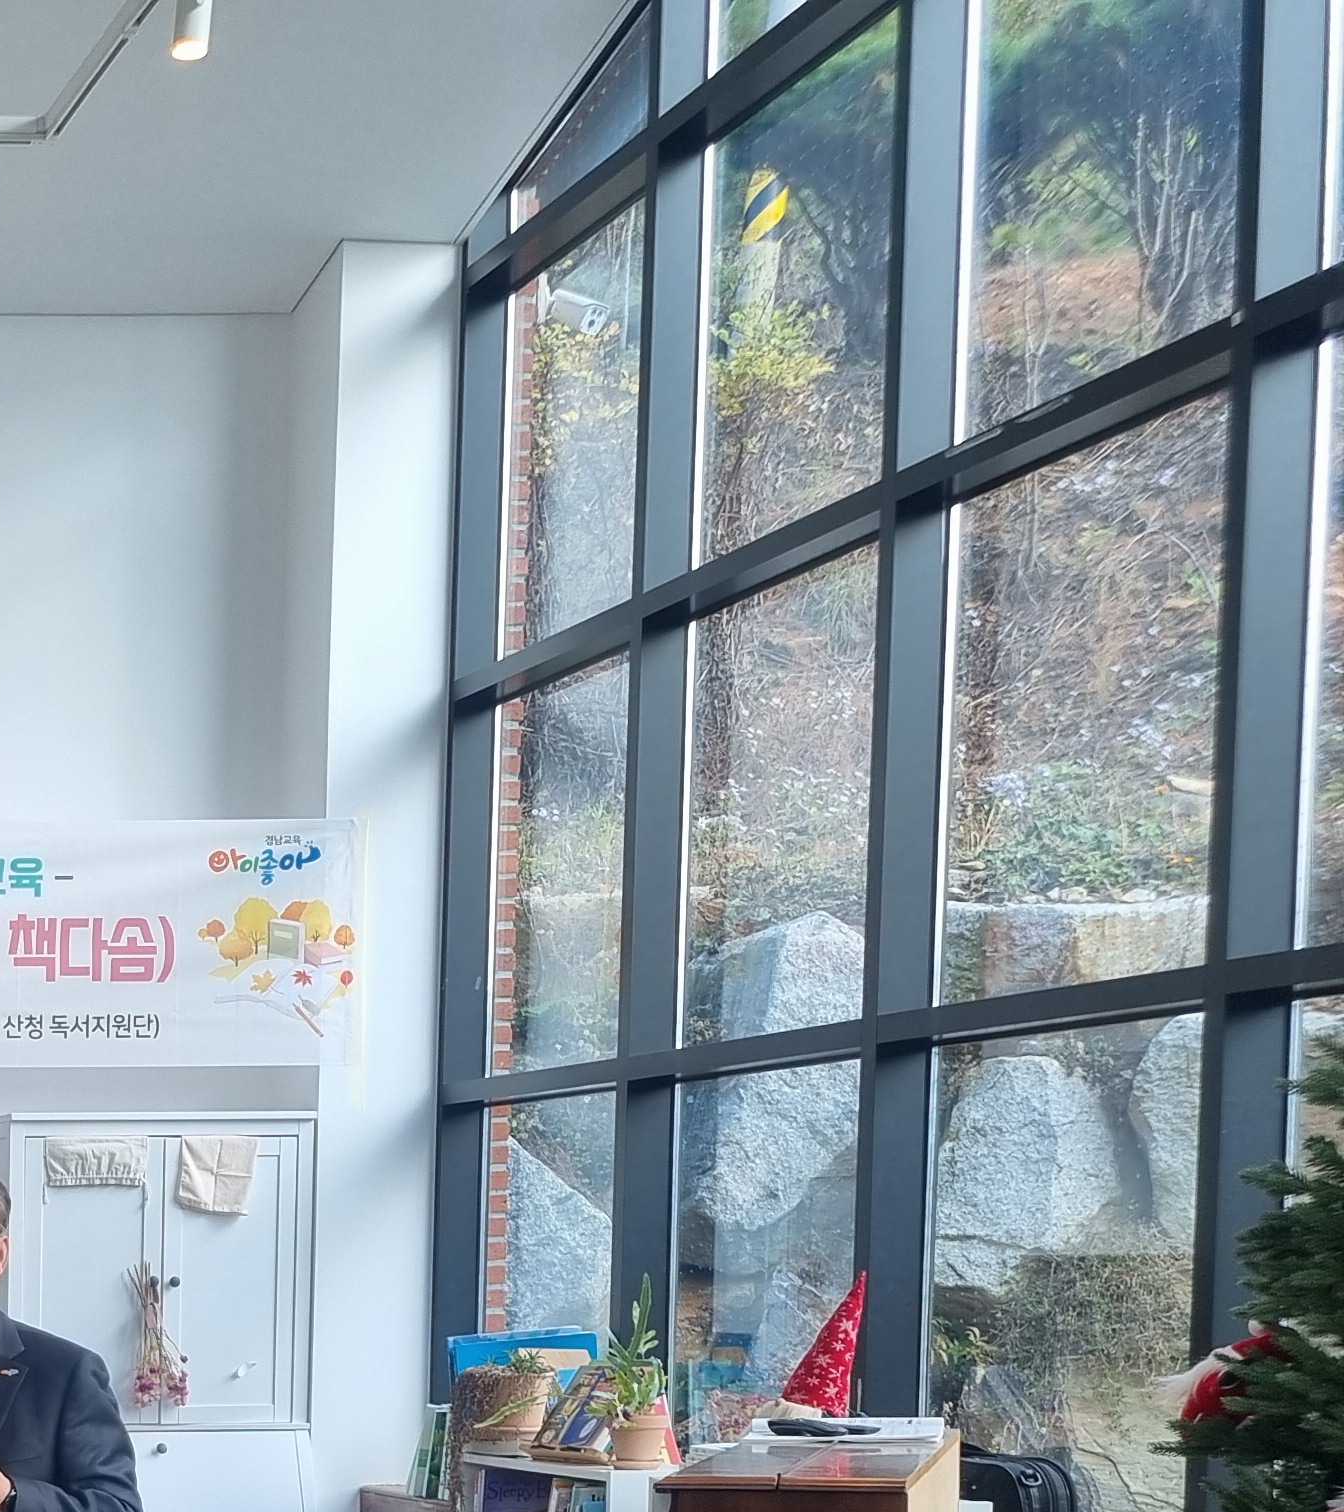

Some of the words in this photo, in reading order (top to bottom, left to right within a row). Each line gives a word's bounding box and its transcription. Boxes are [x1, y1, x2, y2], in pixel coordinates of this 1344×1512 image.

[264, 834, 302, 847] 경남교육
[7, 913, 175, 984] 책다솜)
[2, 1014, 43, 1040] 산청
[48, 1013, 160, 1040] 독서지원단)
[486, 1480, 536, 1502] Sleepy
